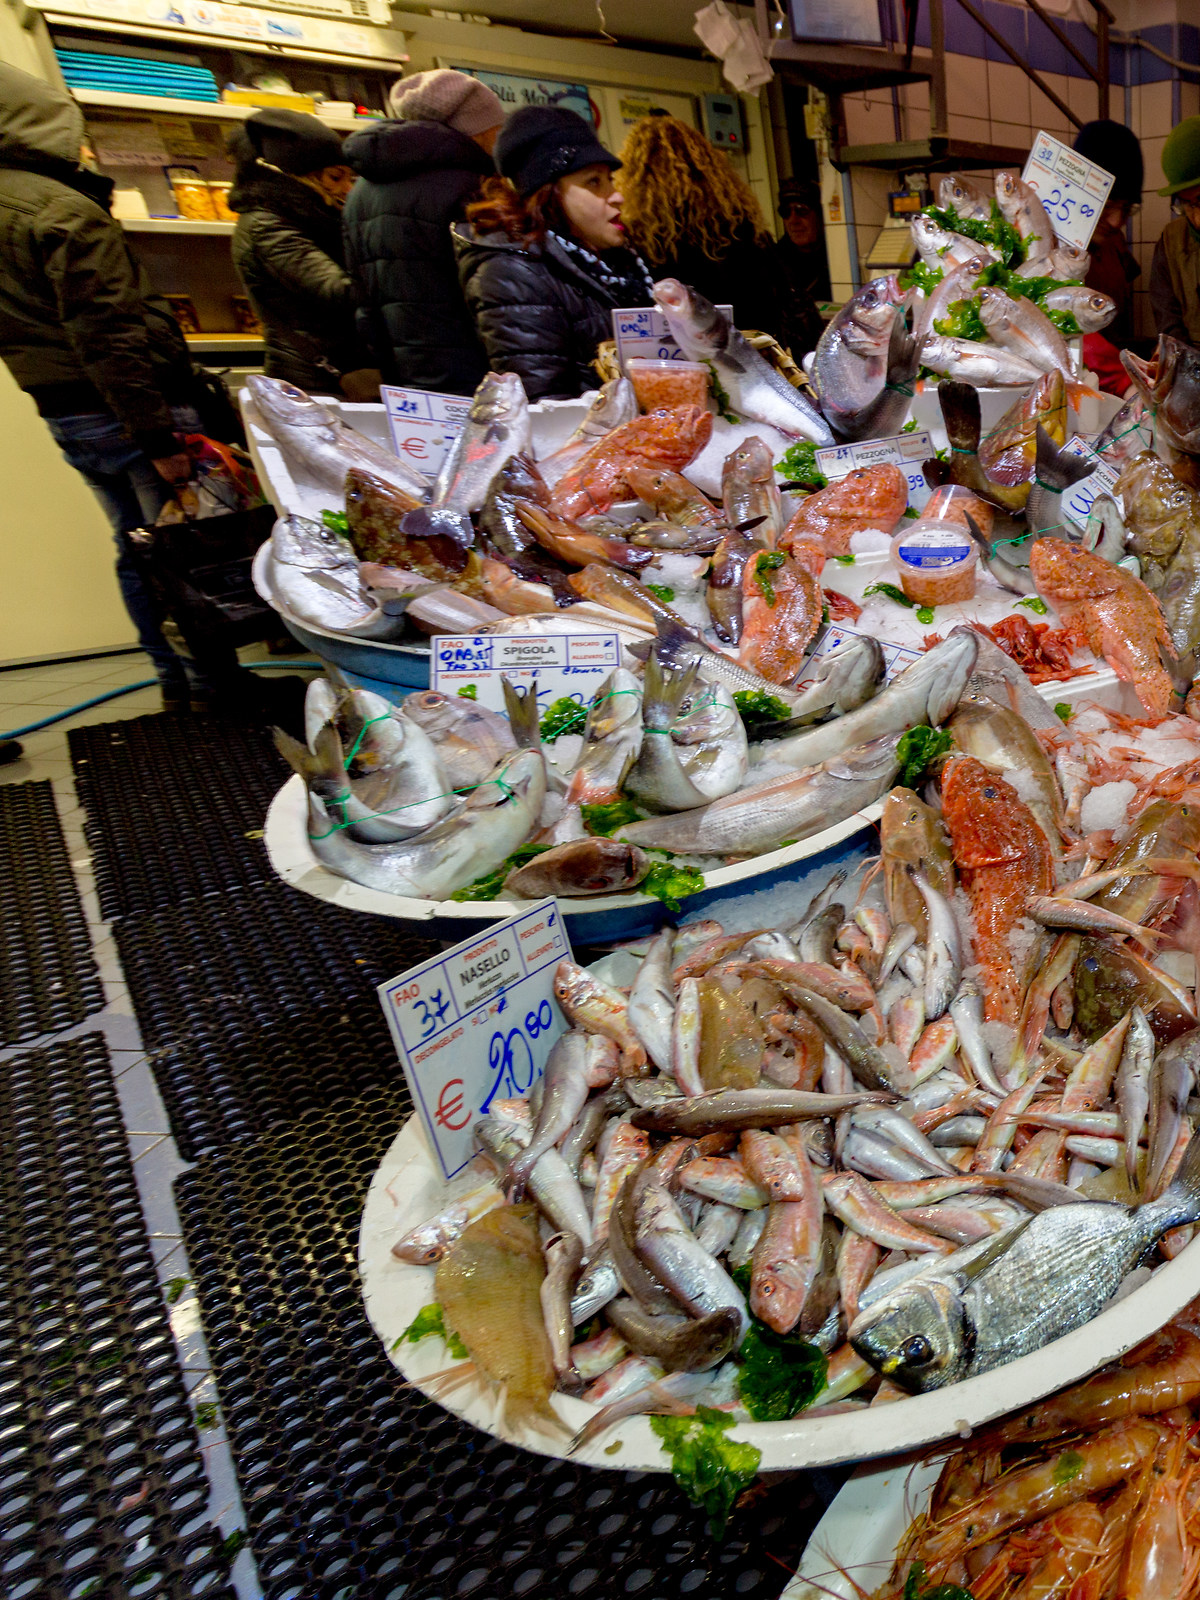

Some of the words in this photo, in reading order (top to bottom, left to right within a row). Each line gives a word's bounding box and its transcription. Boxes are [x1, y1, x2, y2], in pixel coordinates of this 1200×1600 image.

[856, 447, 897, 461] PEZZOGNA
[830, 629, 845, 639] FAO
[503, 646, 556, 655] SPIGOLA
[520, 922, 545, 940] PESCATO
[463, 939, 498, 962] PRODOTTO
[526, 941, 554, 962] ALLEVATO
[460, 948, 510, 986] NASELLO
[394, 983, 420, 1007] FAO
[413, 988, 450, 1037] 37
[414, 1027, 465, 1064] DECONGELATO
[434, 1078, 473, 1131] €
